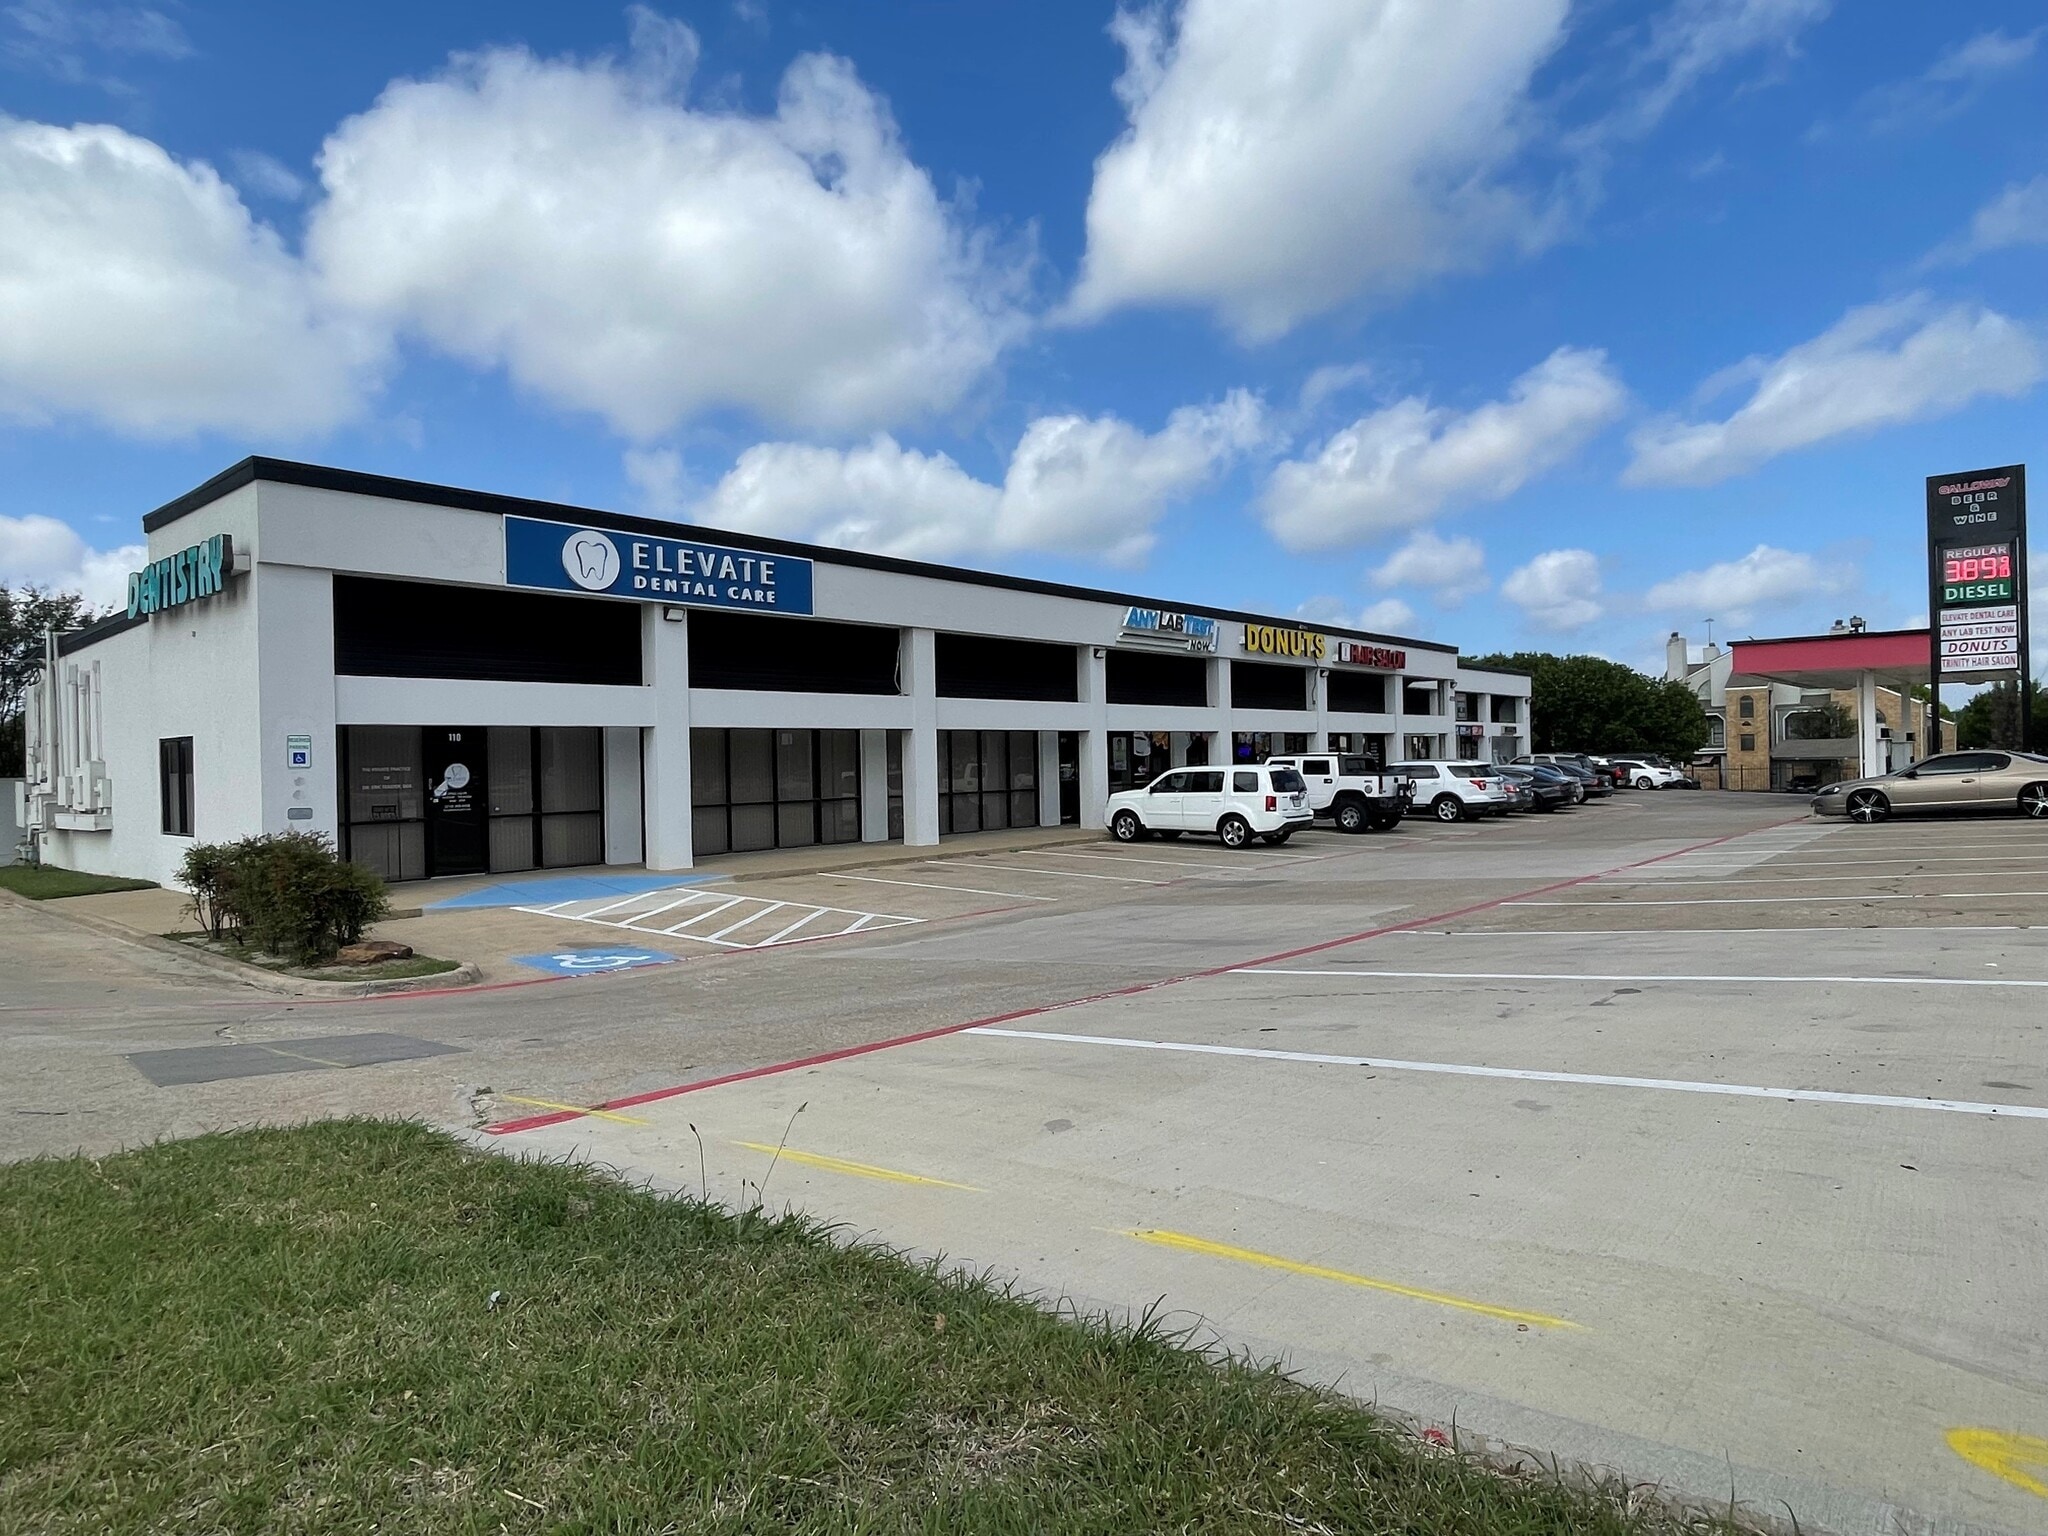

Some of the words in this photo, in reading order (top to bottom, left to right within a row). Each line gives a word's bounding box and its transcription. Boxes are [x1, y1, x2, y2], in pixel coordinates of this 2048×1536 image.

[1951, 492, 1998, 505] BEER
[1953, 512, 1997, 525] WINE
[1946, 546, 2007, 559] REGULAR
[632, 542, 776, 586] ELEVATE
[127, 534, 224, 620] DENTISTRY
[633, 575, 718, 599] DENTAL
[727, 586, 776, 604] CARE
[1945, 584, 2009, 600] DIESEL
[1122, 606, 1160, 630] ANY
[1158, 610, 1184, 632] LAB
[1942, 613, 1968, 621] ELEVATE
[1970, 611, 1995, 620] DENTAL
[1997, 609, 2015, 618] CARE
[1941, 629, 1957, 637] ANY
[1959, 627, 1974, 636] LAB
[1975, 626, 1993, 635] TEST
[1994, 625, 2015, 634] NOW
[1189, 639, 1211, 652] NOW
[1244, 624, 1326, 660] DONUTS
[1948, 640, 2009, 653] DONUTS
[1942, 658, 1970, 668] TRINITY
[1971, 657, 1990, 667] HAIR
[1991, 655, 2016, 666] SALON
[448, 733, 461, 742] 110
